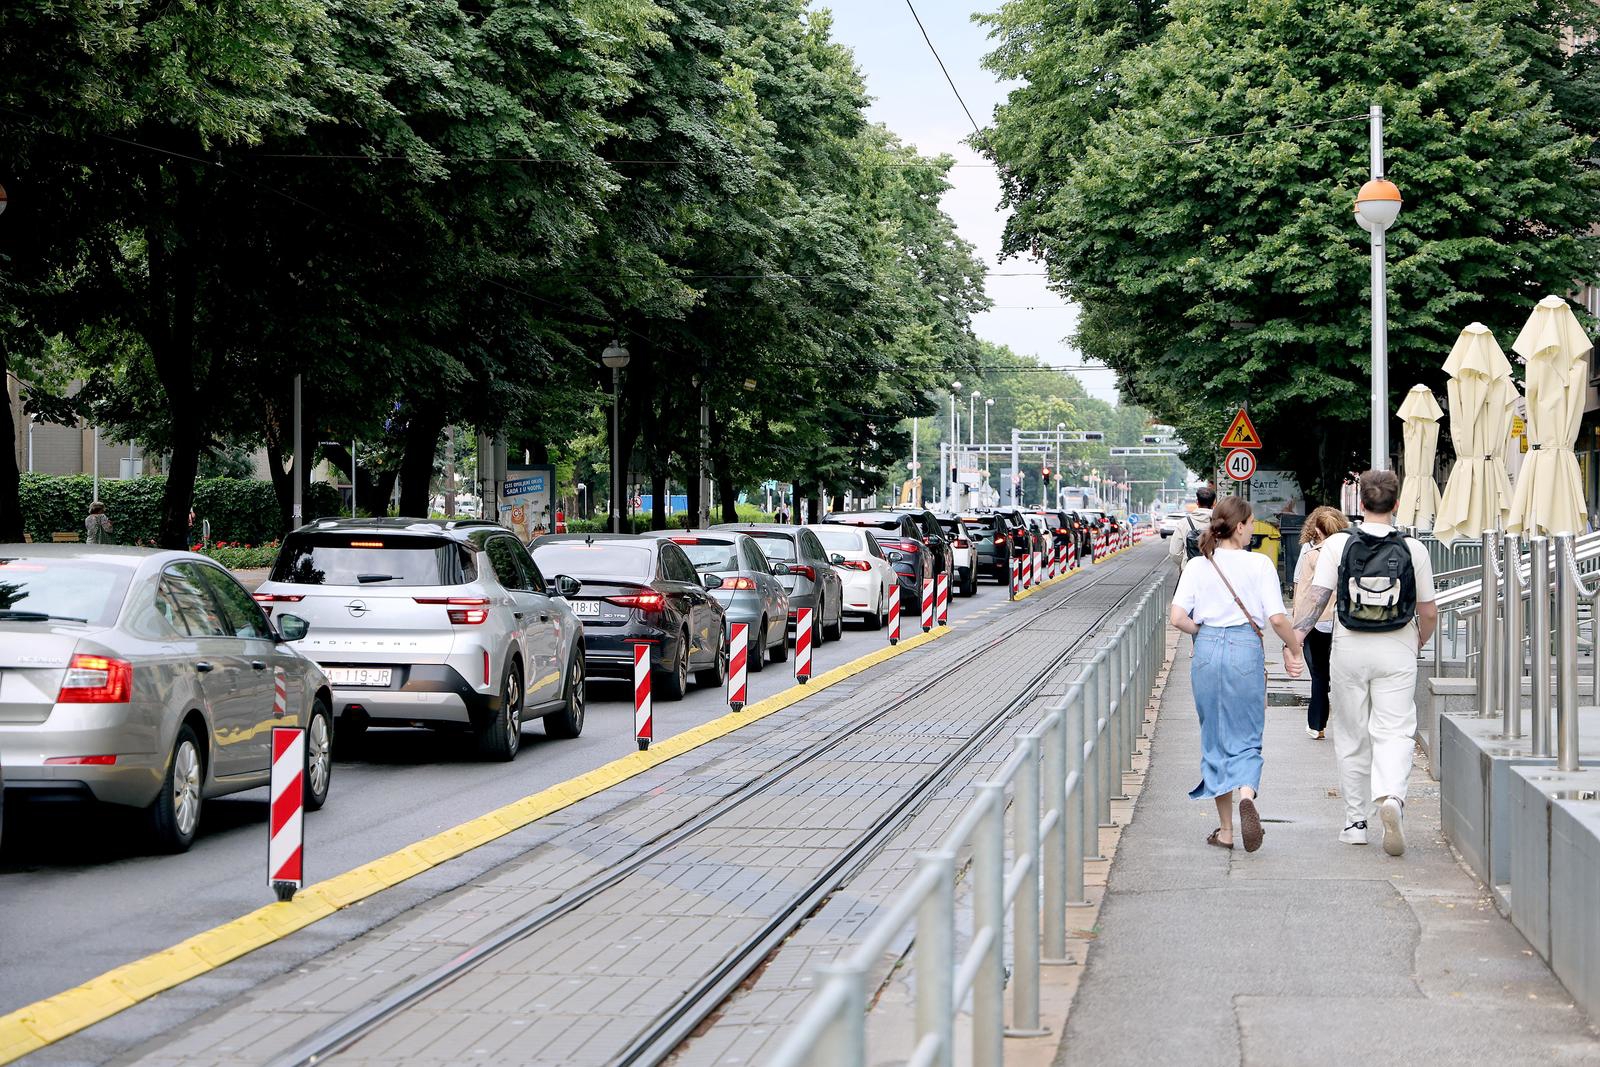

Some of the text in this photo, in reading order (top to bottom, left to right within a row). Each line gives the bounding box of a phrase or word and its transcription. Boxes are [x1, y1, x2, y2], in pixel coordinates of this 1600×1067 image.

[1232, 457, 1249, 472] 40
[1253, 479, 1279, 489] ČATEŽ
[321, 669, 389, 683] A 119-JR
